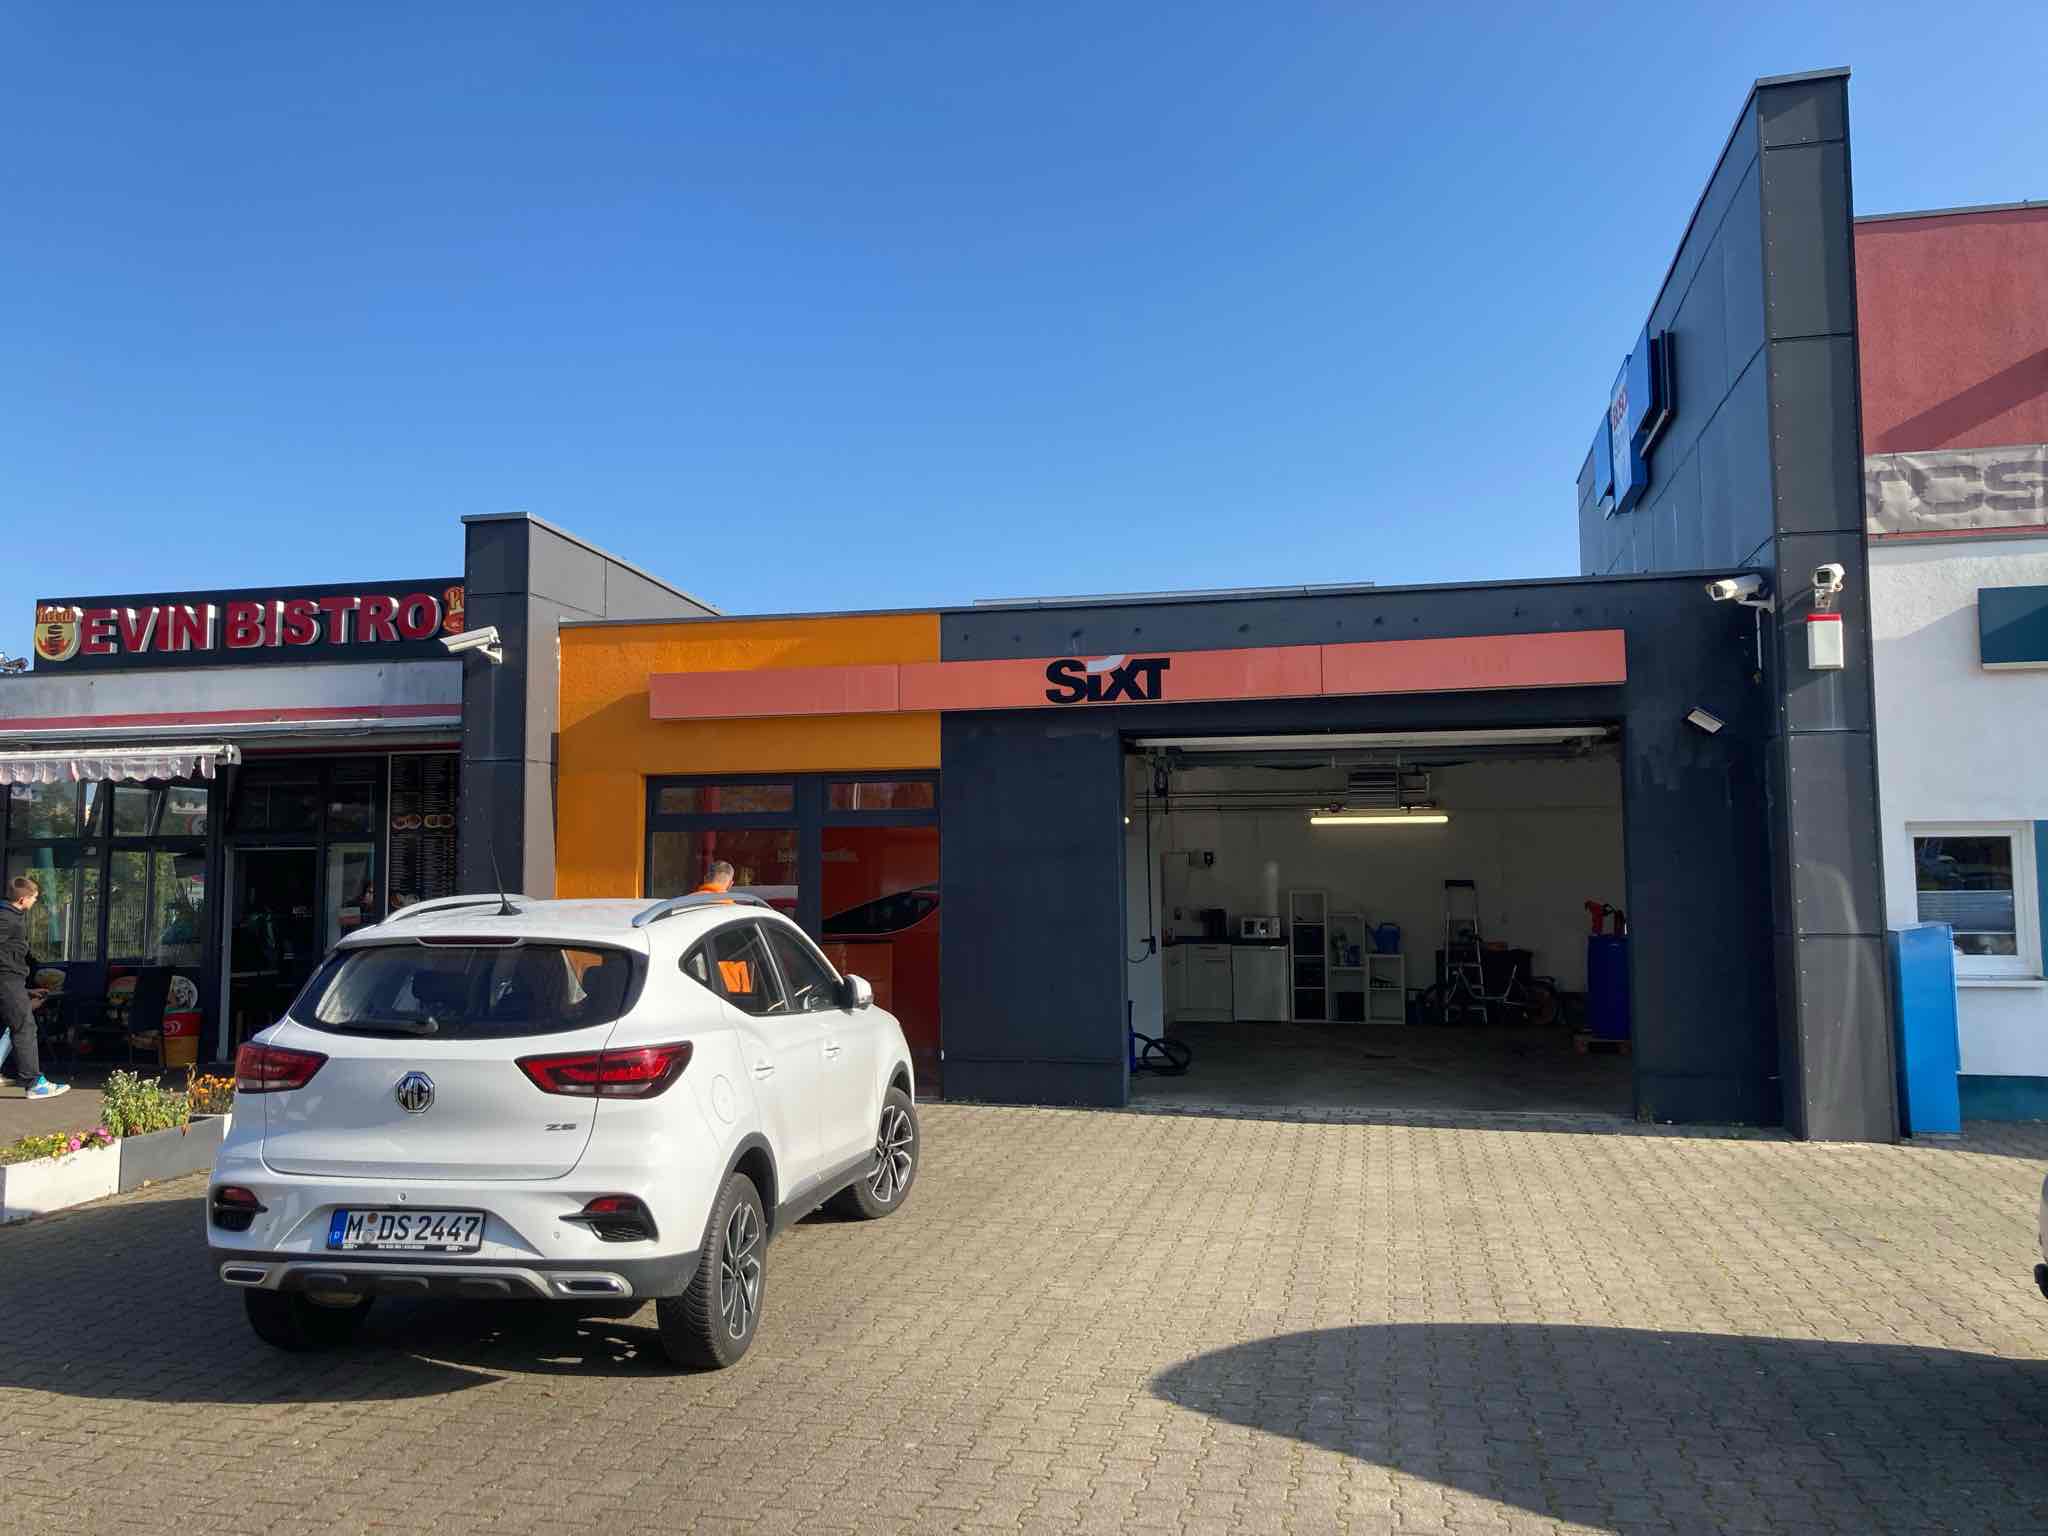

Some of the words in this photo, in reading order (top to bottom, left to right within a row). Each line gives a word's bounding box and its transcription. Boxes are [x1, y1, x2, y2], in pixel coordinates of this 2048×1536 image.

[80, 603, 216, 655] EVIN
[226, 593, 442, 649] BISTRO
[345, 1215, 364, 1241] M
[377, 1214, 411, 1241] DS
[414, 1215, 481, 1242] 2447
